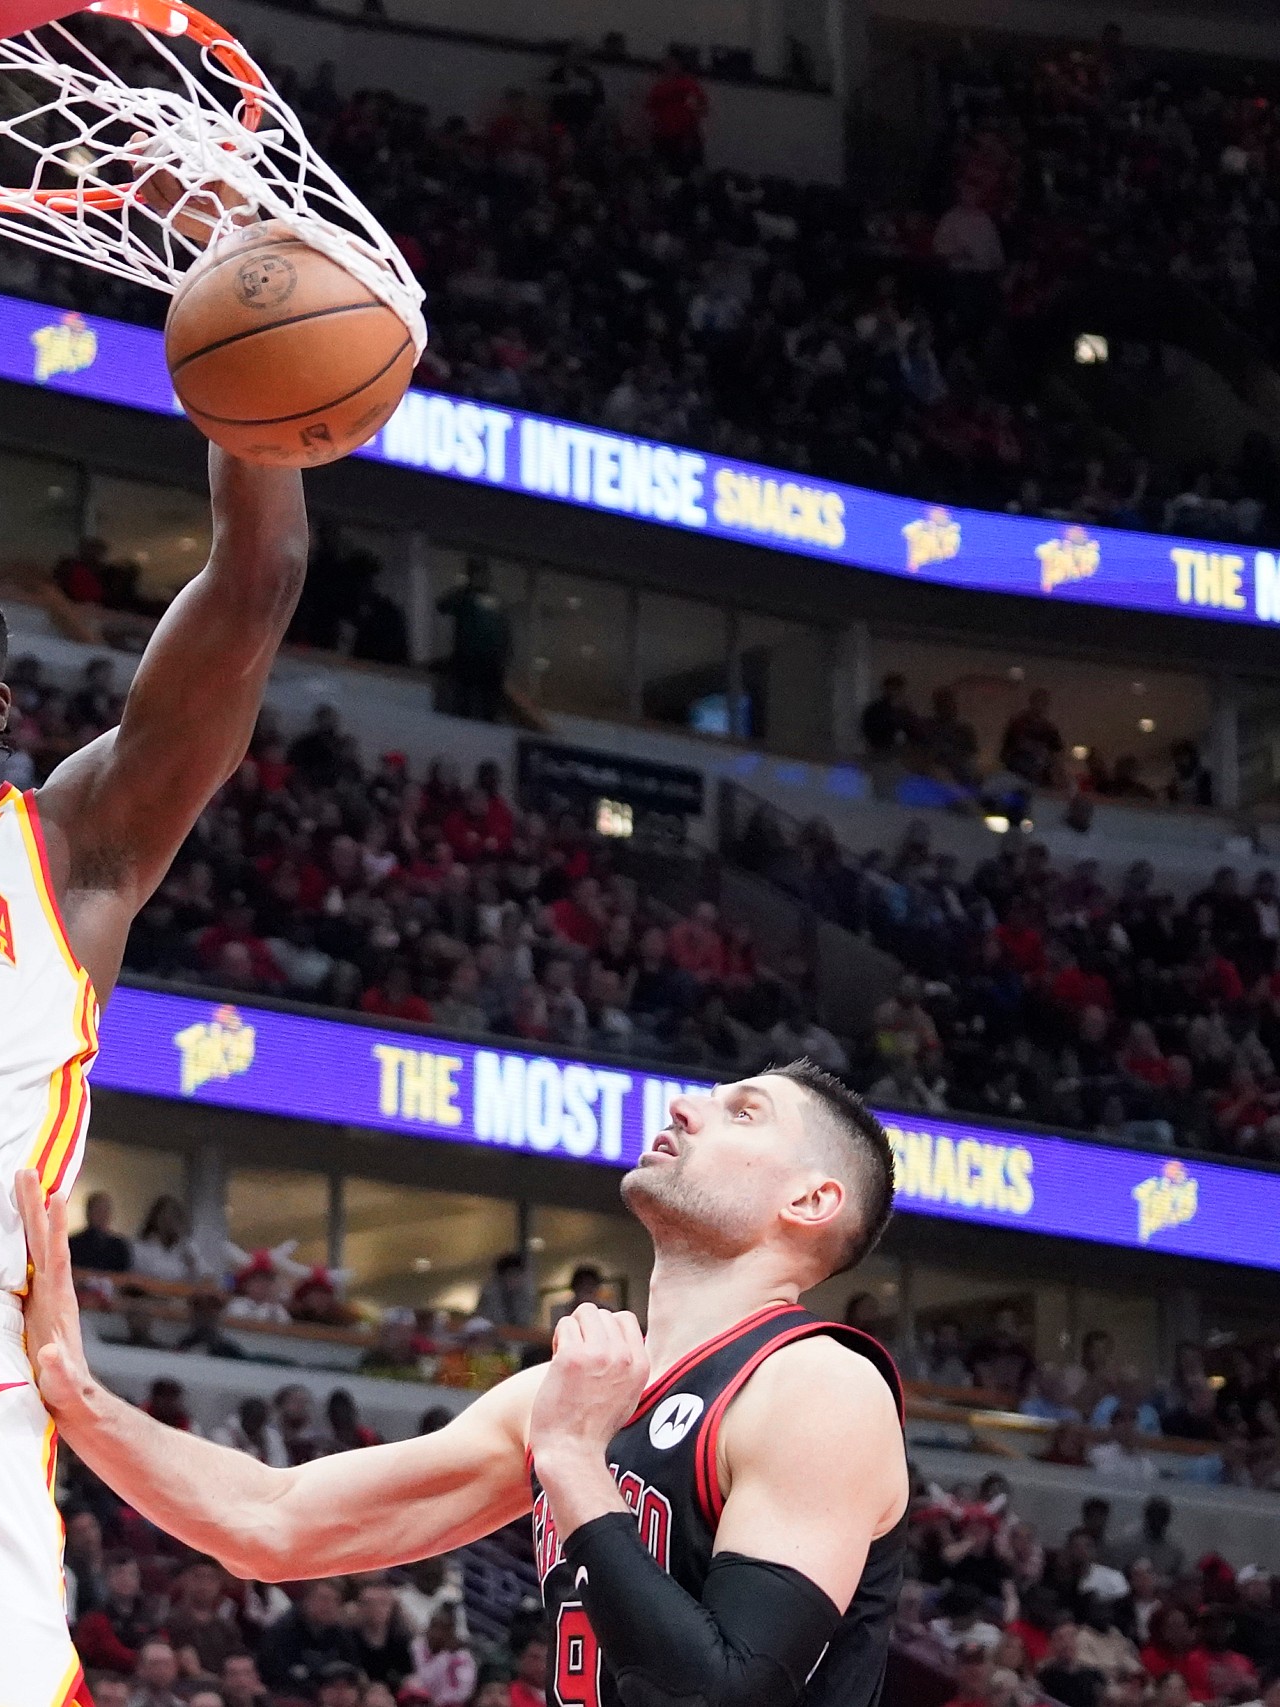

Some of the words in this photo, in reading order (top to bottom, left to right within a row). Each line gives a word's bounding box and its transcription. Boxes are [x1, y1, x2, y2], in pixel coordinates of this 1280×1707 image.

[521, 417, 707, 527] INTENSE
[714, 468, 846, 549] SNACKS
[1171, 546, 1247, 611] THE
[373, 1044, 462, 1126] THE
[473, 1050, 632, 1161] MOST
